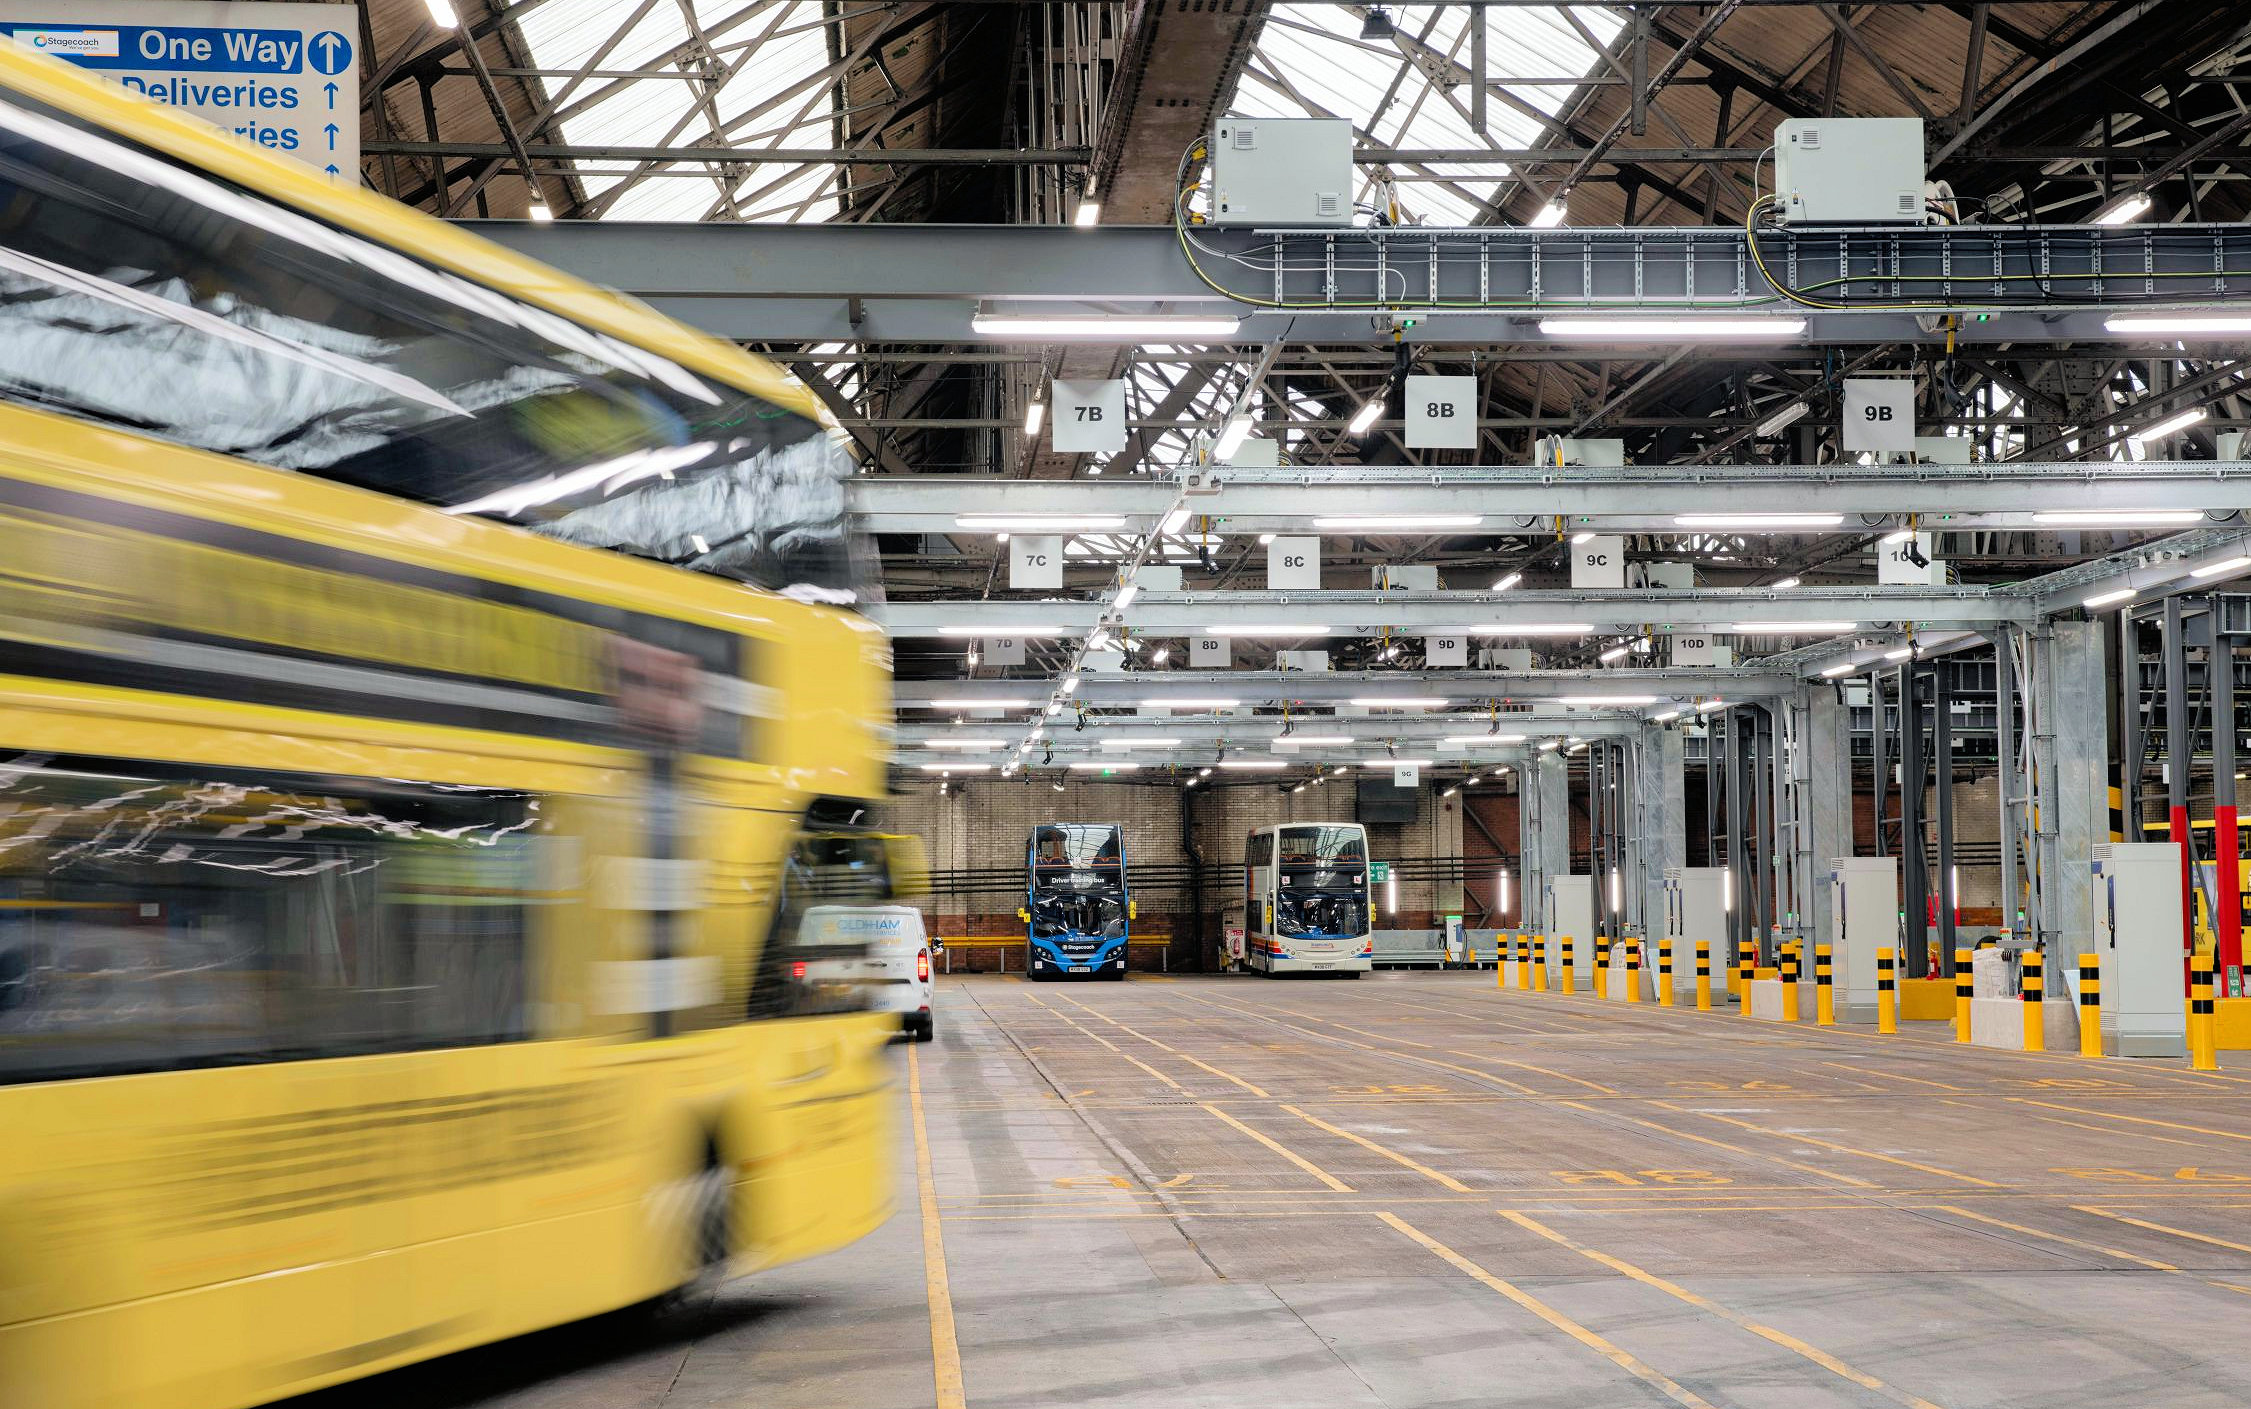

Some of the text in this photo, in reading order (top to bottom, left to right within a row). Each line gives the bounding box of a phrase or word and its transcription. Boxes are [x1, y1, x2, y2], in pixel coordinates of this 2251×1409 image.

[47, 37, 99, 47] Stagecoach
[138, 30, 299, 71] One Way
[1074, 406, 1104, 422] 7B
[1427, 402, 1455, 418] 8B
[1864, 405, 1893, 422] 9B
[1026, 555, 1047, 567] 7C
[1284, 556, 1305, 568] 8C
[1586, 555, 1607, 567] 9C
[1891, 551, 1910, 562] 10
[995, 639, 1013, 648] 7D
[1202, 640, 1218, 649] 8D
[1438, 640, 1455, 649] 9D
[1680, 639, 1705, 648] 10D
